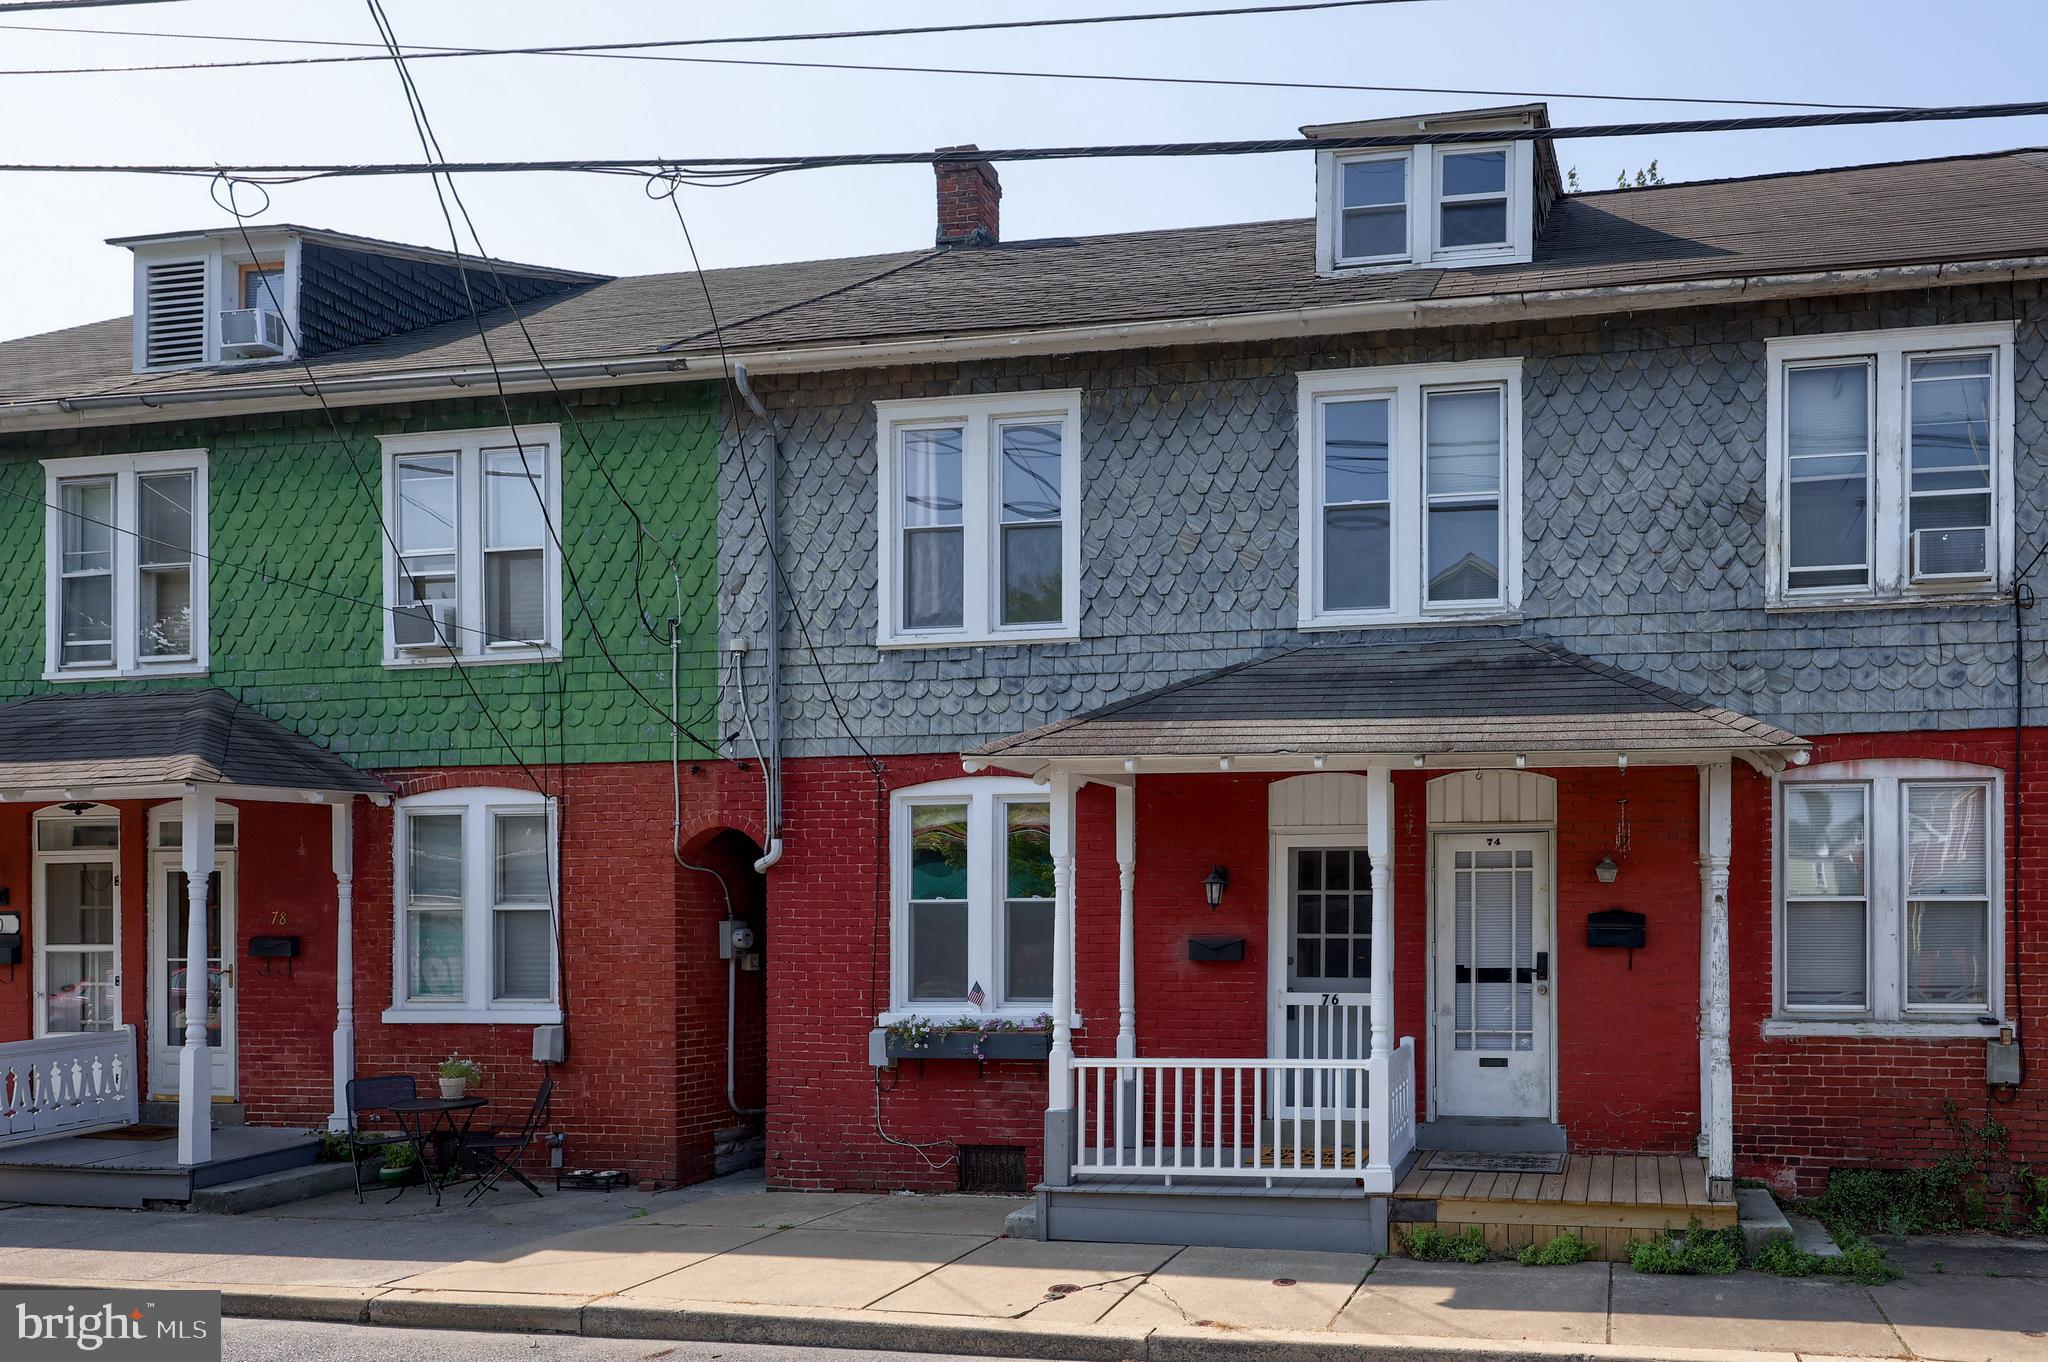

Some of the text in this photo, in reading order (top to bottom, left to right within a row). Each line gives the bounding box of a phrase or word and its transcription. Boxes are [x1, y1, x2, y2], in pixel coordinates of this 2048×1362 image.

[1486, 837, 1501, 846] 74
[271, 911, 287, 925] 78
[1322, 993, 1339, 1006] 76
